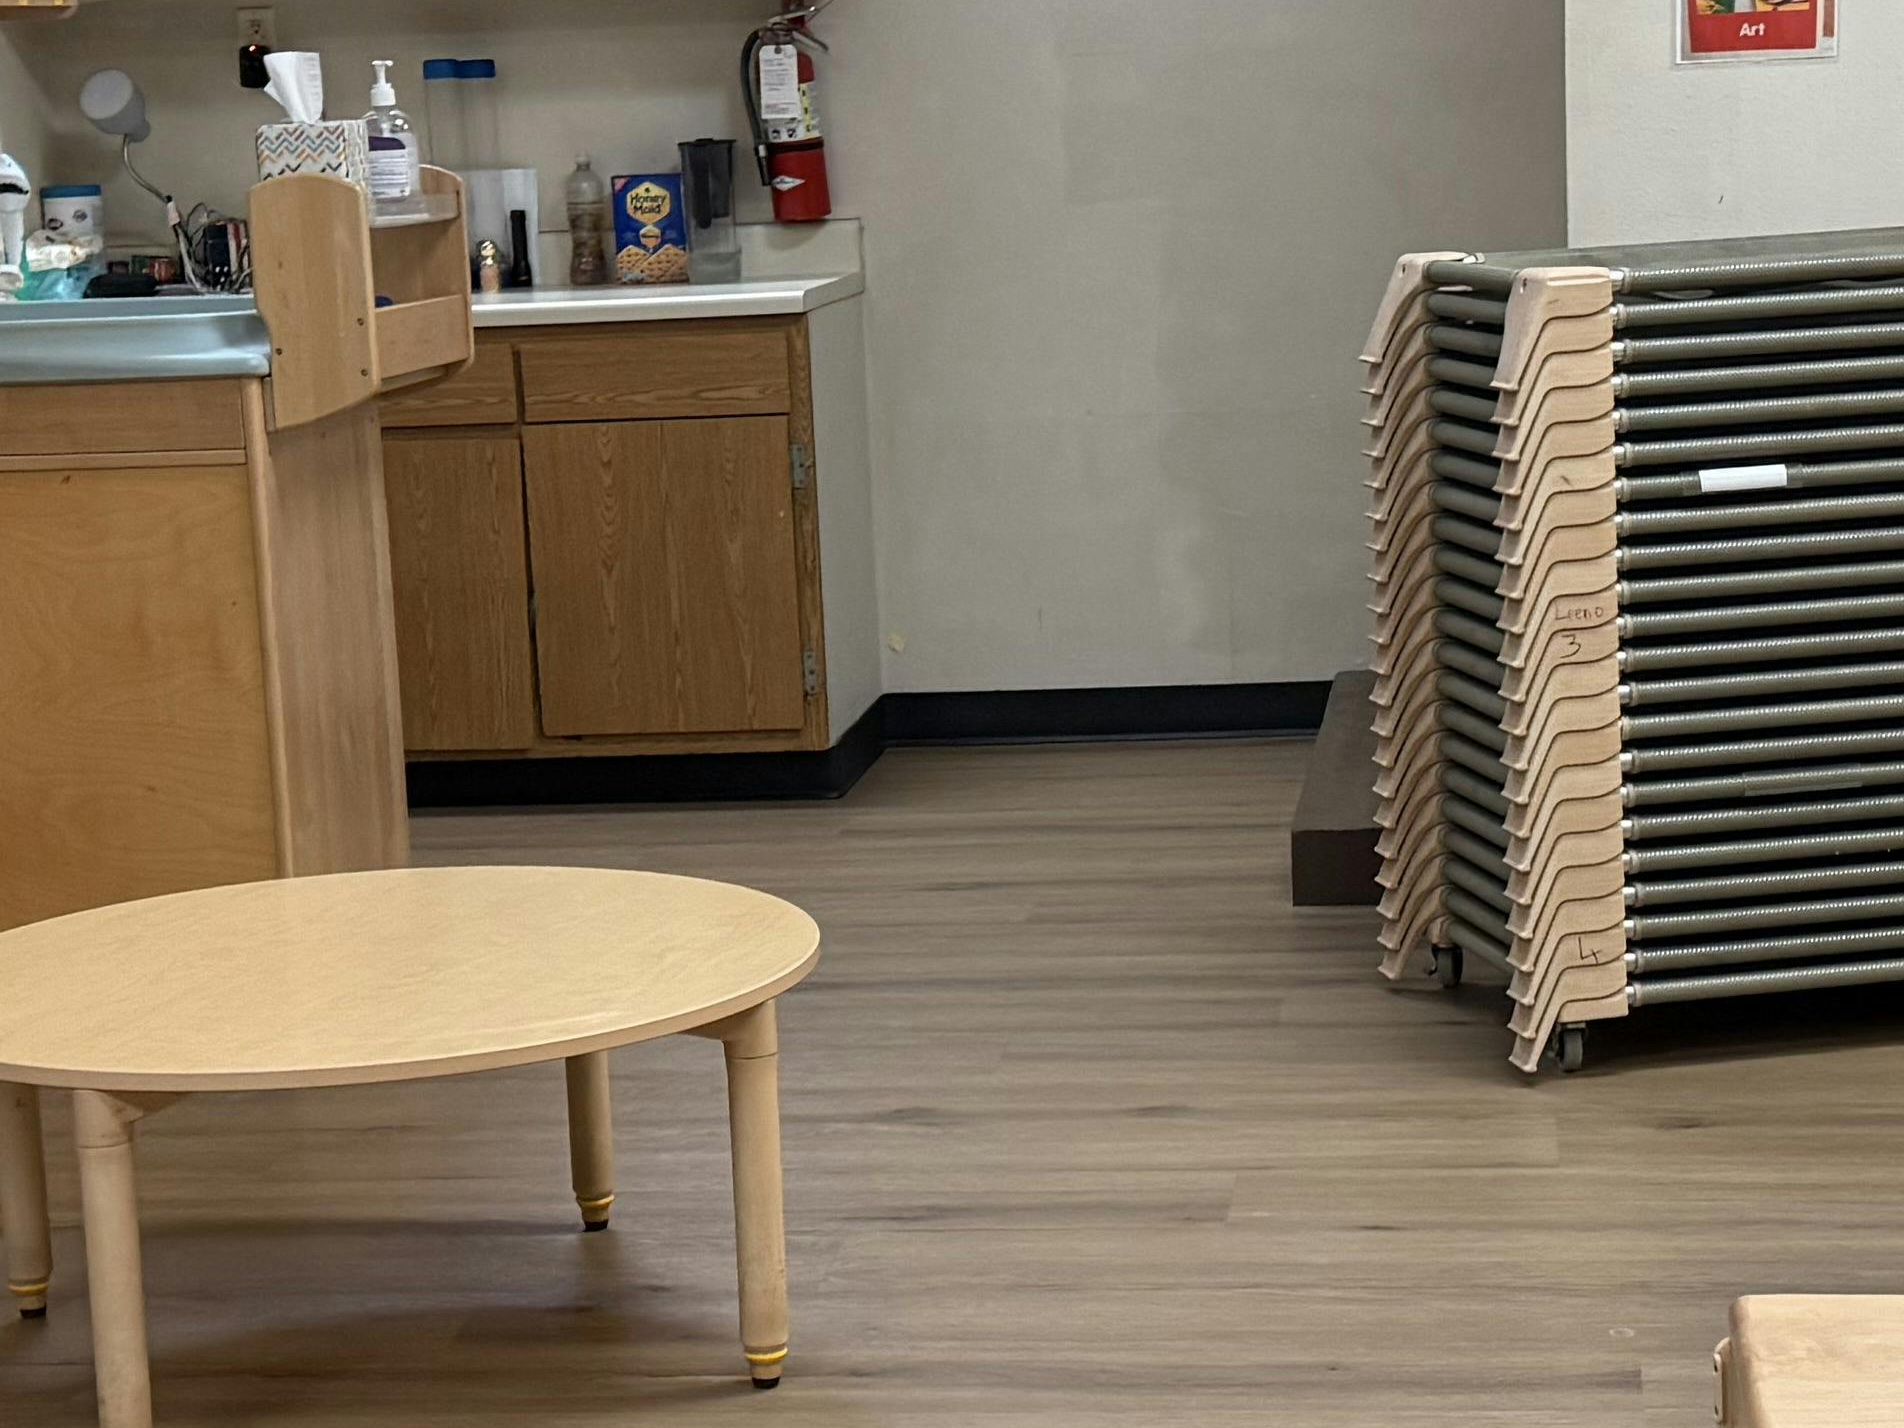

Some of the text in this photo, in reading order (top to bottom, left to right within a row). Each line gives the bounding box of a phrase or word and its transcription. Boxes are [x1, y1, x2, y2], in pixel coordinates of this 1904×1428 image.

[1739, 22, 1766, 37] Art
[1559, 633, 1582, 659] 3
[1578, 936, 1603, 965] 4
